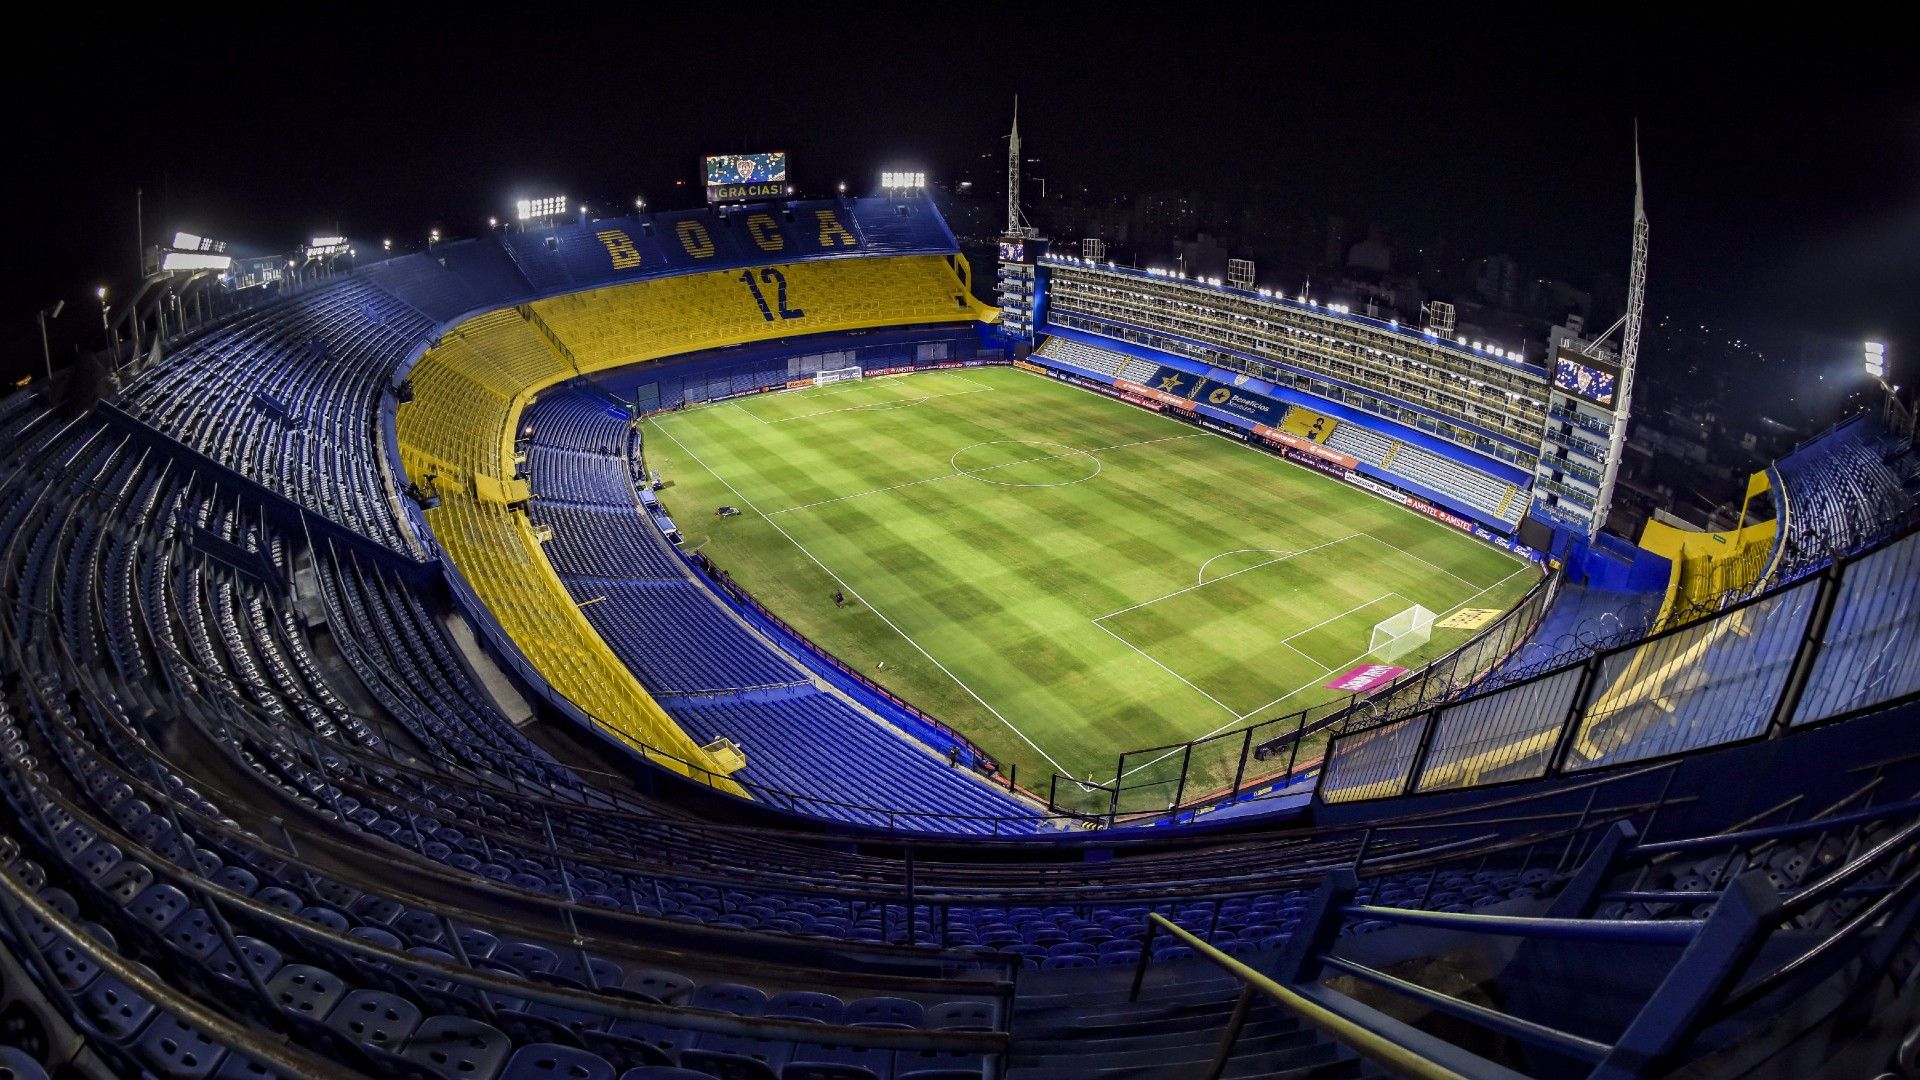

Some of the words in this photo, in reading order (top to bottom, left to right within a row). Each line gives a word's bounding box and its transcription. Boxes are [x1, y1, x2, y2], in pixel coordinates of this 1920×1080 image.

[596, 210, 856, 270] BOCA
[739, 267, 805, 321] 12
[1231, 394, 1270, 412] Beneficios
[1412, 501, 1438, 518] AMSTEL
[1445, 515, 1472, 532] AMSTEL
[1475, 527, 1491, 541] Ford
[1494, 536, 1511, 550] Ford
[1513, 545, 1531, 559] Ford
